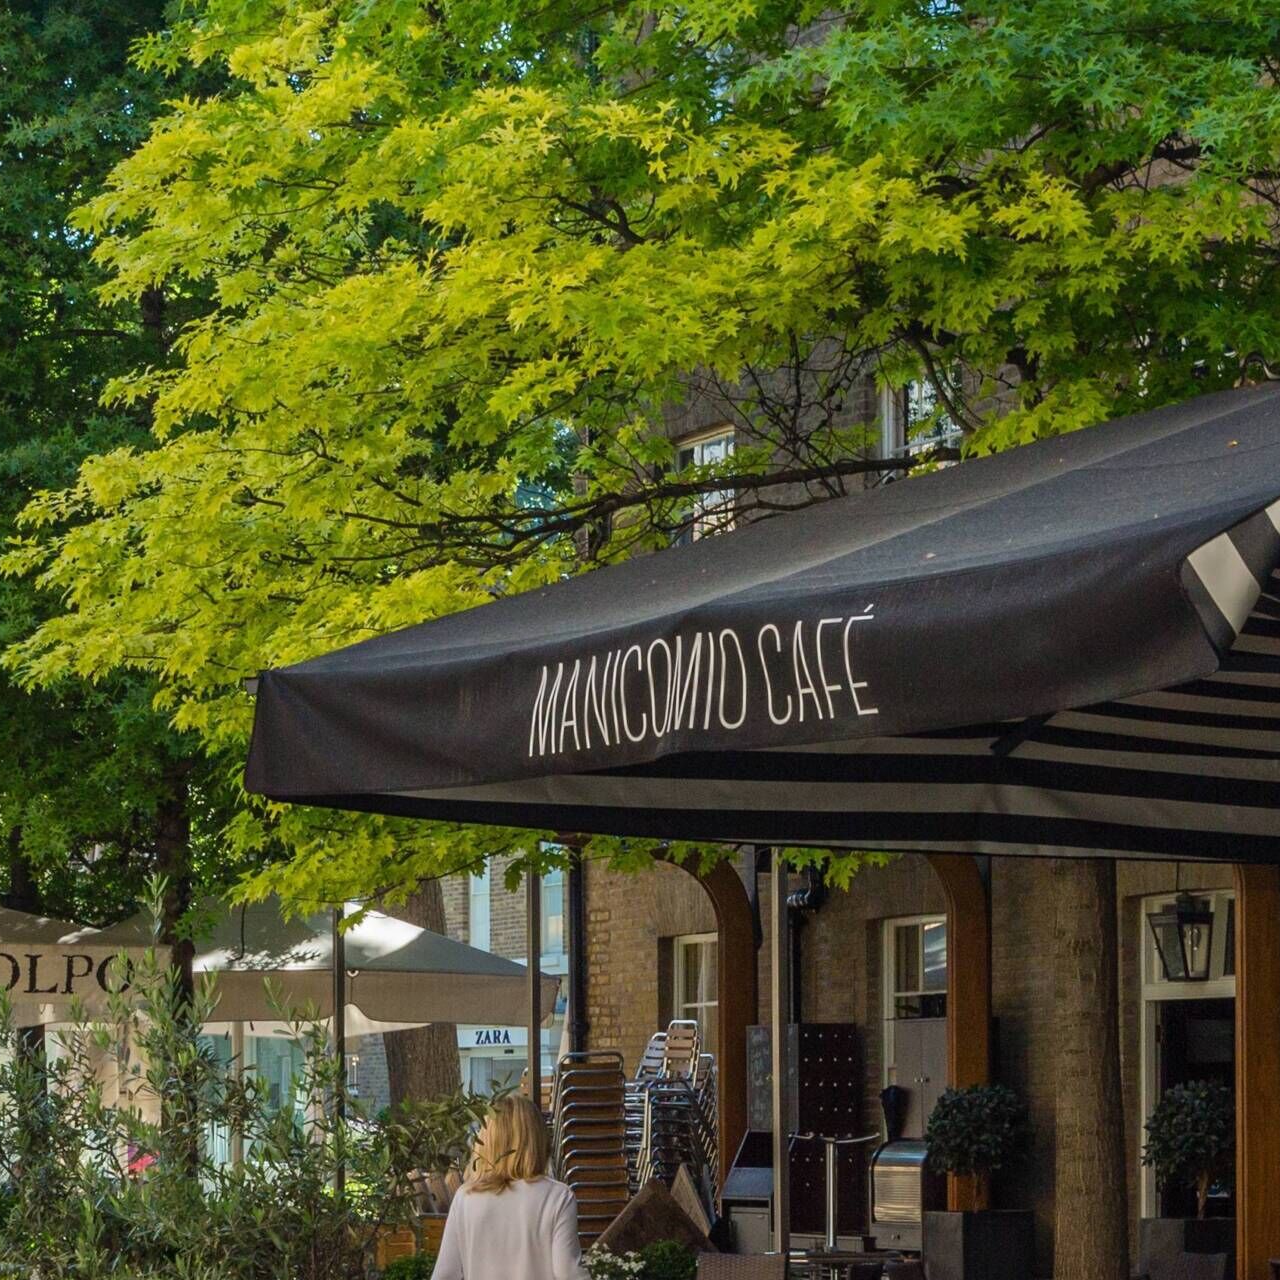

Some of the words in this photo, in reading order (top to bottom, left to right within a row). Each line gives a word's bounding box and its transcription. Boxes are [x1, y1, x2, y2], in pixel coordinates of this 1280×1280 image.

[528, 628, 747, 757] MANICOMIO
[758, 603, 879, 725] CAFÉ
[475, 1029, 511, 1045] ZARA
